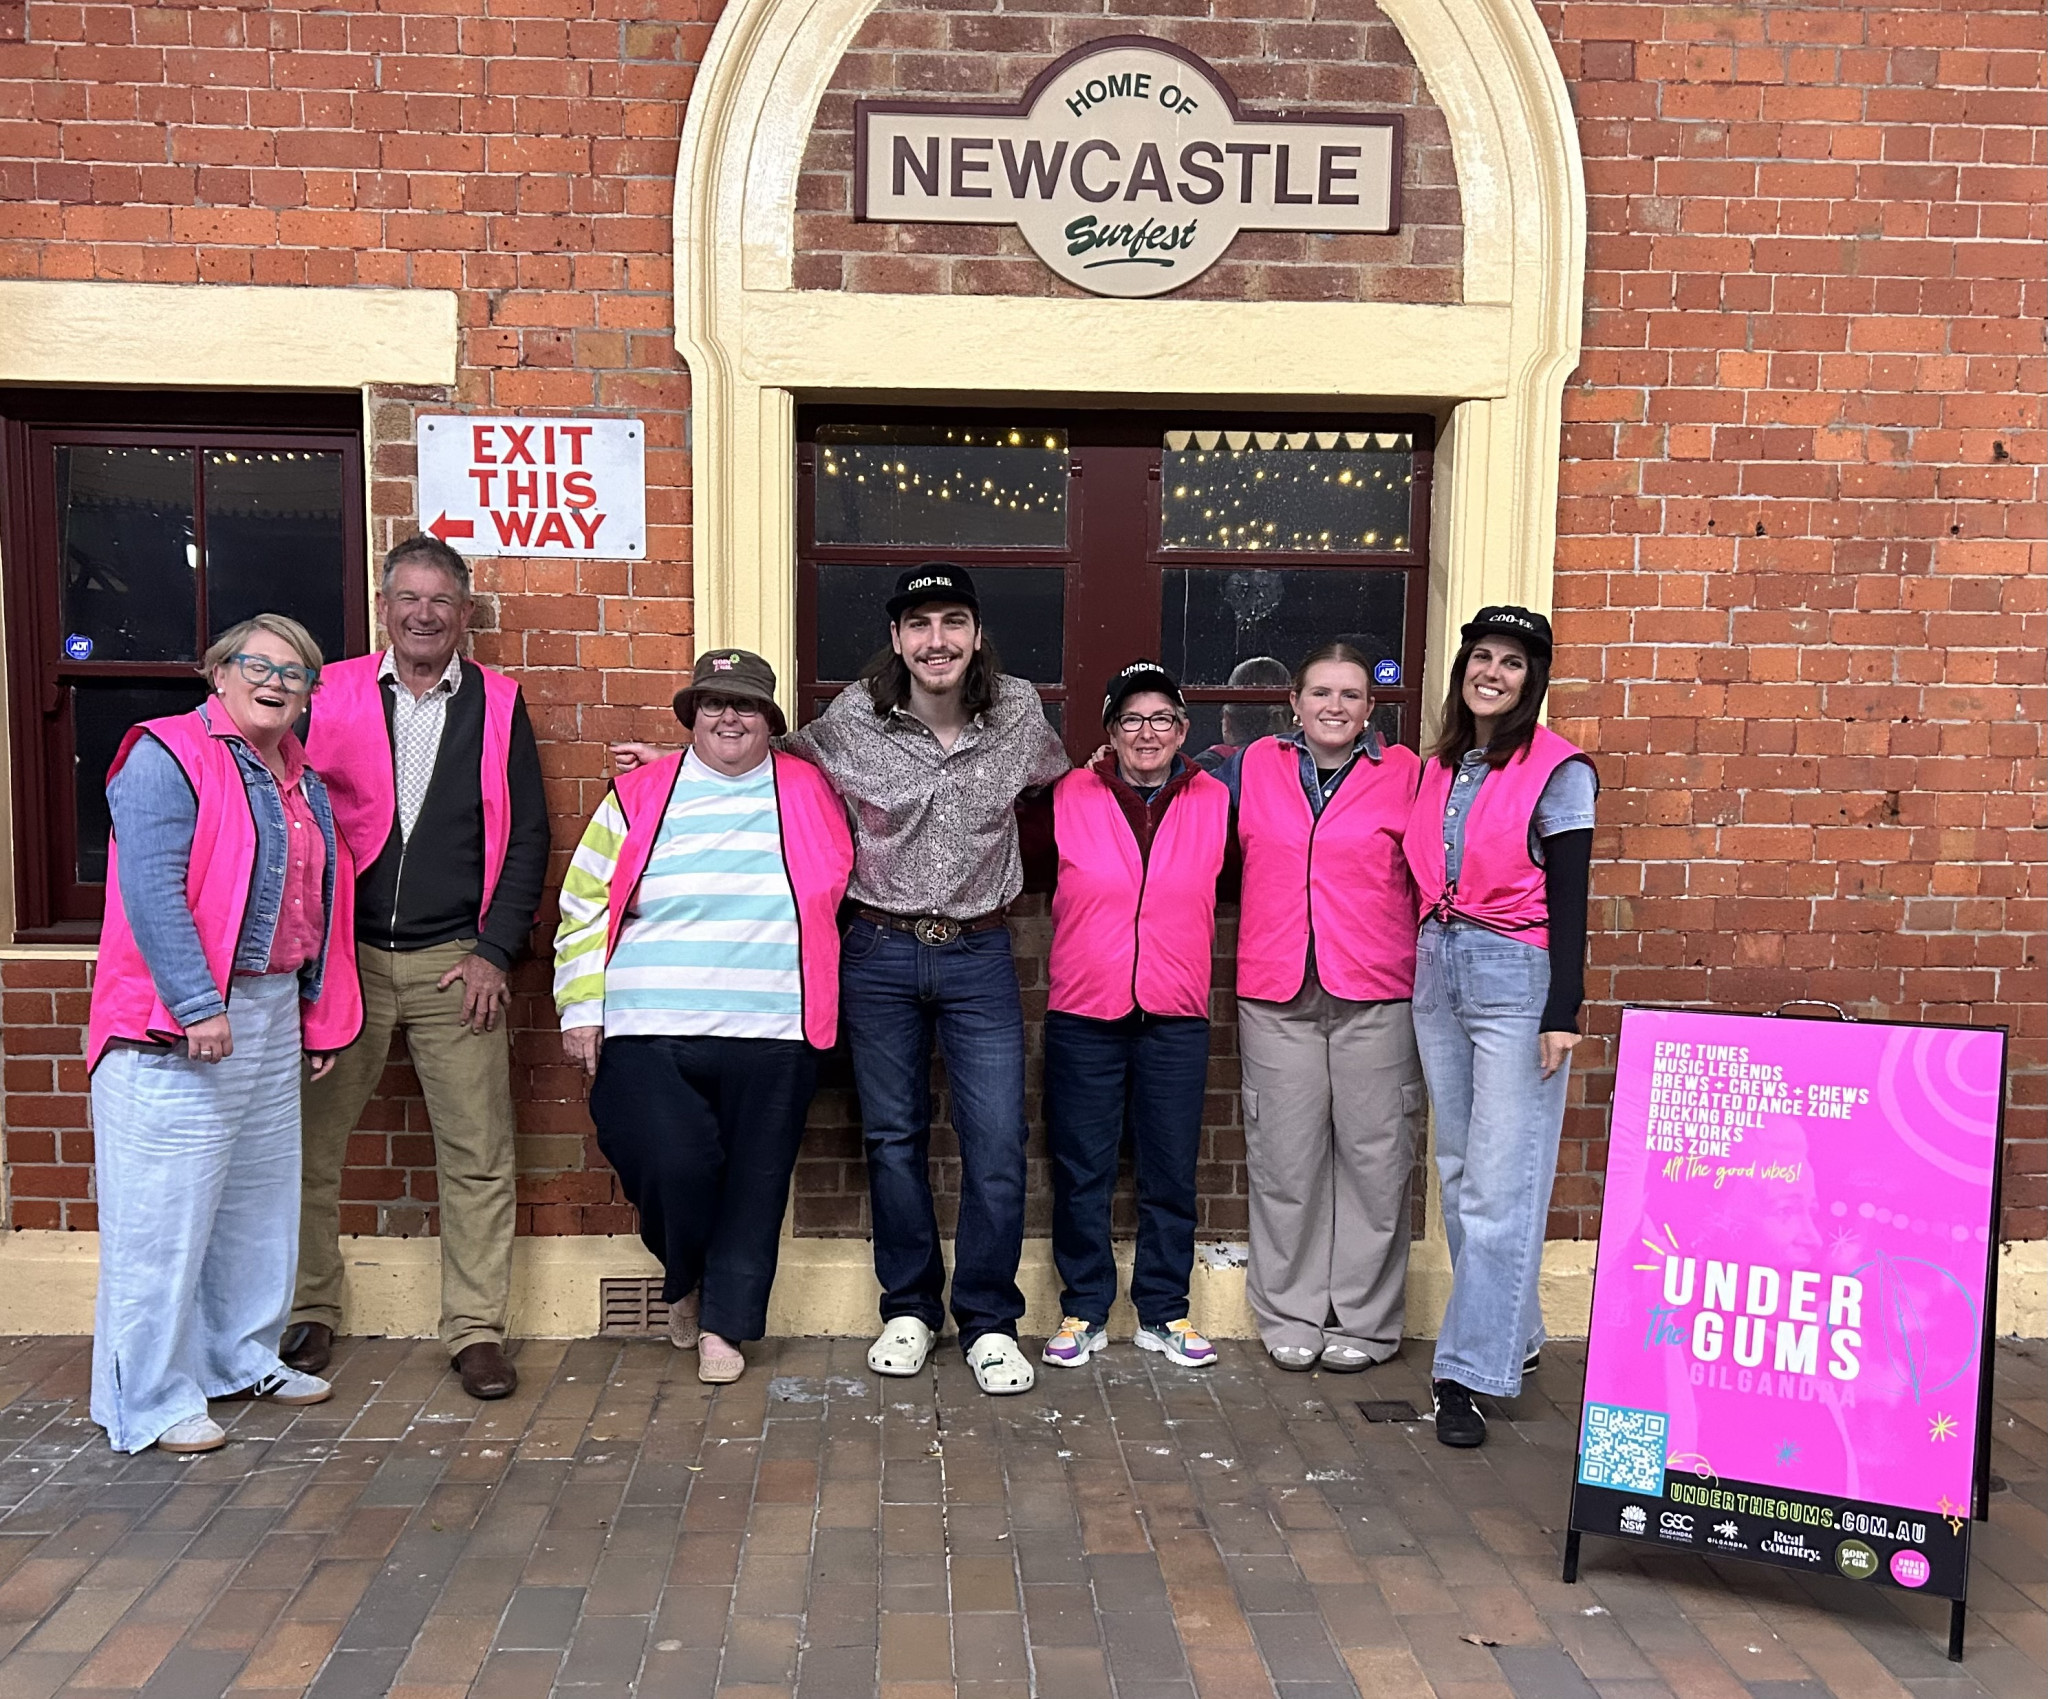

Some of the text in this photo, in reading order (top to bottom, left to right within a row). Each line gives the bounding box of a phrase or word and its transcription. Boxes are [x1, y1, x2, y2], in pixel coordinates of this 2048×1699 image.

[1065, 73, 1198, 118] HOME OF
[891, 136, 1362, 205] NEWCASTLE
[1064, 216, 1198, 258] Surfest
[473, 425, 593, 465] EXIT
[468, 469, 597, 509] THIS
[489, 510, 607, 549] WAY
[908, 576, 953, 591] COO-EE
[70, 641, 89, 651] ADT
[1121, 663, 1165, 677] UNDER
[1379, 667, 1396, 677] ADT
[1655, 1041, 1749, 1063] EPIC TUNES
[1653, 1056, 1783, 1081] MUSIC LEGENDS
[1651, 1072, 1710, 1092] BREWS
[1729, 1078, 1788, 1098] CREWS
[1808, 1084, 1870, 1105] CHEWS
[1648, 1103, 1766, 1129] BUCKING BULL
[1650, 1088, 1852, 1120] DEDICATED DANCE ZONE
[1647, 1119, 1744, 1143] FIREWORKS
[1645, 1134, 1732, 1158] KIDS ZONE
[1661, 1155, 1684, 1183] All
[1713, 1160, 1756, 1190] good
[1761, 1161, 1802, 1183] vibes!
[1663, 1255, 1864, 1329] UNDER
[1691, 1310, 1862, 1381] GUMS
[1689, 1362, 1856, 1409] GILGANDRA
[1659, 1511, 1695, 1531] GSC
[1670, 1482, 1926, 1543] UNDERTHEGUMS.COM.AU
[1620, 1519, 1646, 1532] NSW
[1659, 1527, 1693, 1539] GILGANDRA
[1707, 1537, 1749, 1550] GILGANDRA
[1760, 1539, 1821, 1562] Country.
[1773, 1530, 1804, 1547] Real
